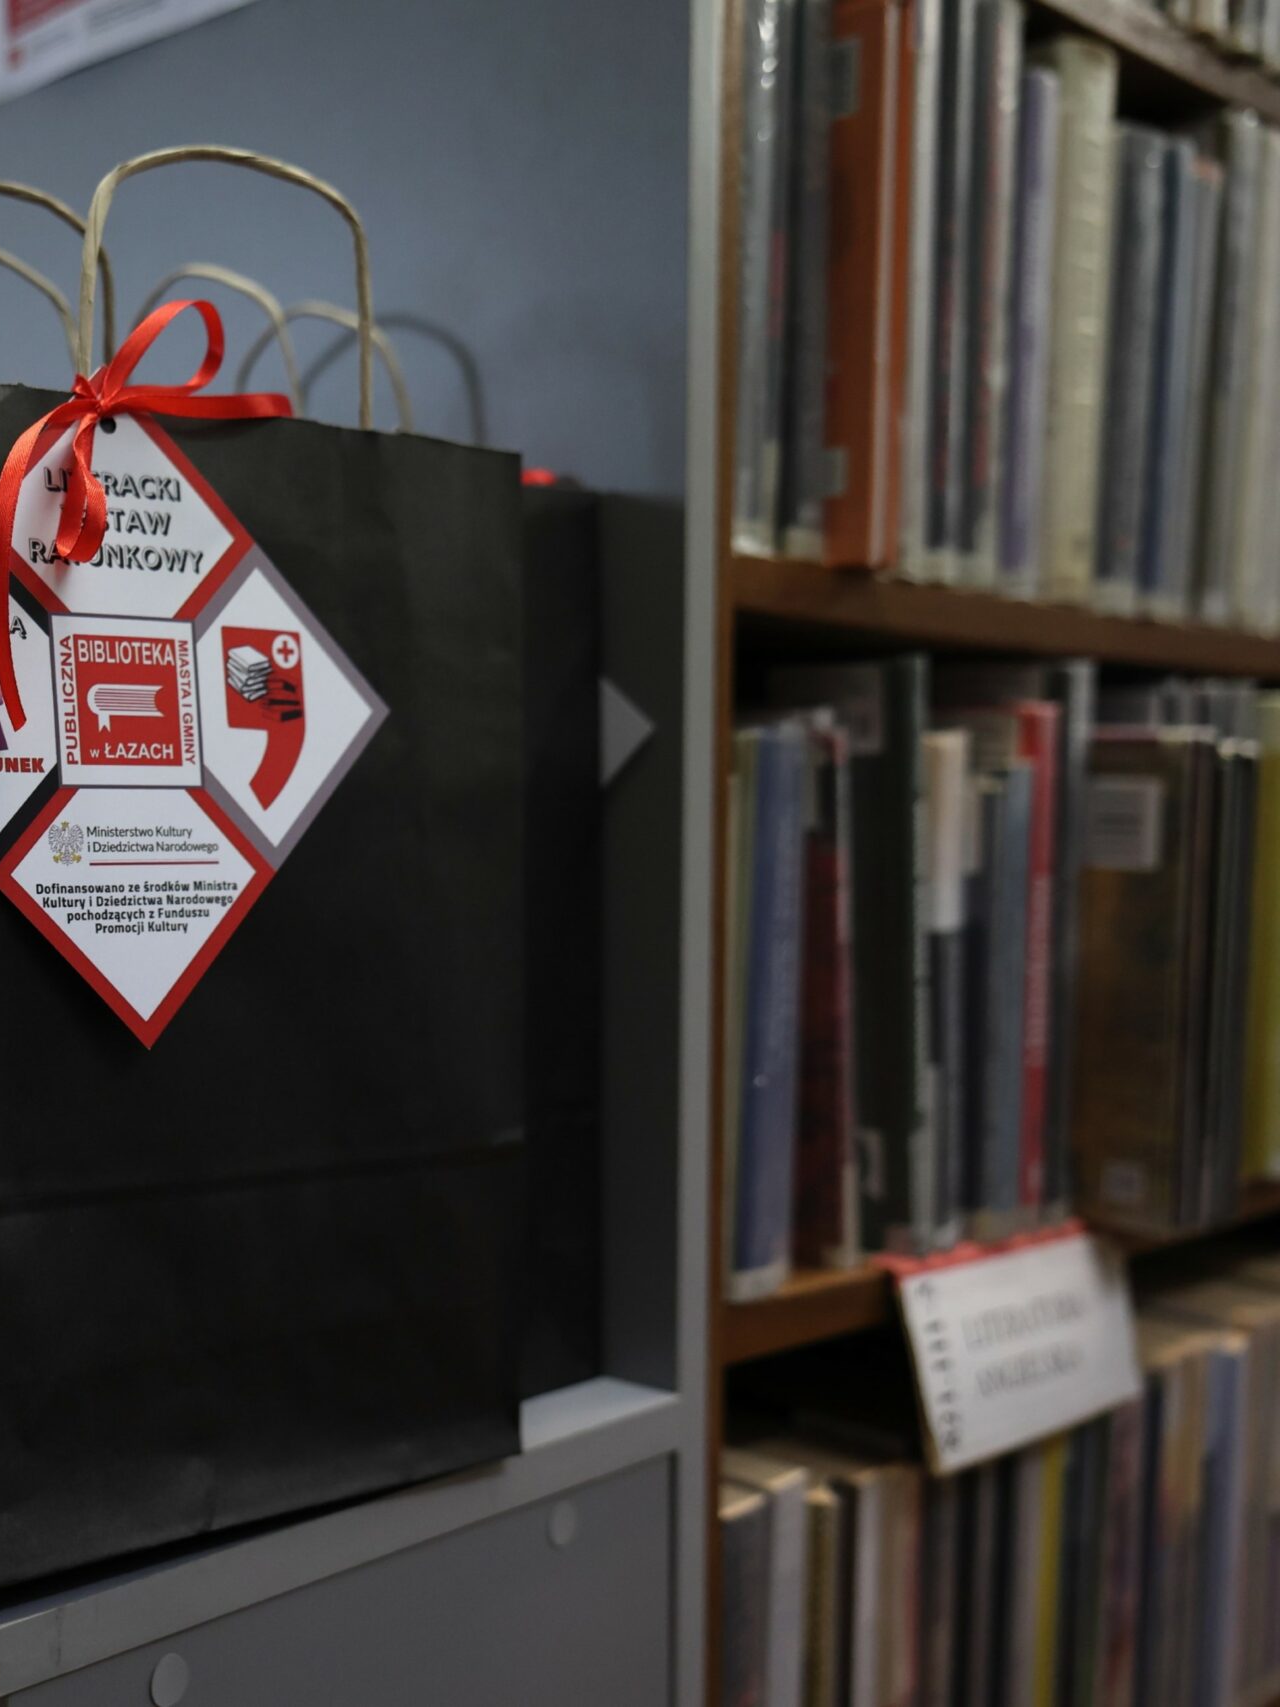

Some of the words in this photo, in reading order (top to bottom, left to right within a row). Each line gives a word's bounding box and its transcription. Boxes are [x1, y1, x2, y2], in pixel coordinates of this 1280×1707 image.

[43, 467, 182, 502] LIRACKI
[28, 537, 204, 574] RAUNKOWY
[77, 639, 176, 666] BIBLIOTEKA
[178, 640, 192, 699] MIASTA
[60, 635, 79, 765] PUBLICZNA
[182, 712, 196, 765] GMINY
[103, 743, 175, 760] ŁAZACH
[86, 826, 154, 838] Ministerstwo
[155, 826, 193, 839] Kultury
[87, 842, 91, 853] i
[93, 841, 155, 853] Dziedzictwa
[156, 842, 219, 854] Narodowego
[35, 882, 125, 894] Dofinansowano
[128, 884, 141, 893] ze
[144, 881, 190, 893] środków
[193, 880, 238, 891] Ministra
[42, 897, 86, 909] Kultury
[96, 895, 163, 907] Dziedzictwa
[166, 894, 233, 907] Narodowego
[67, 909, 145, 923] pochodzących
[149, 911, 155, 919] z
[158, 908, 210, 918] Funduszu
[95, 922, 144, 935] Promocji
[148, 921, 188, 934] Kultury
